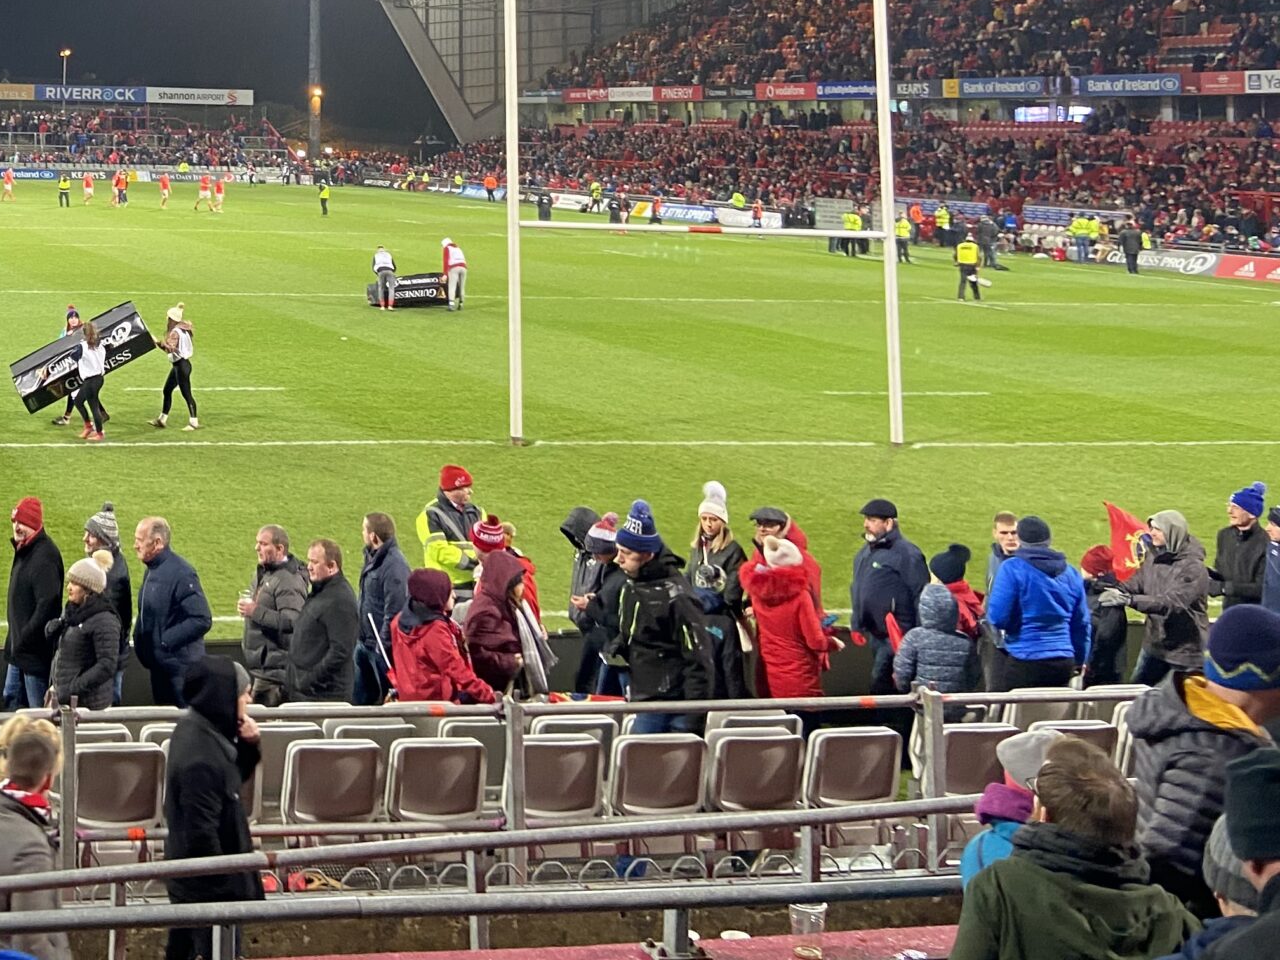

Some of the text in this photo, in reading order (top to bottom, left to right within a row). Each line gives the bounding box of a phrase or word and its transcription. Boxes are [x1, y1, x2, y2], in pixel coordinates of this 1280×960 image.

[775, 85, 805, 95] vodafone
[963, 81, 1024, 93] Bank of Ireland
[1087, 79, 1160, 91] Bank of Ireland
[45, 86, 135, 101] RIVERROCK
[158, 91, 224, 101] shannon AIRPORT
[661, 87, 693, 99] PINERGY
[394, 288, 437, 300] GUINNESS
